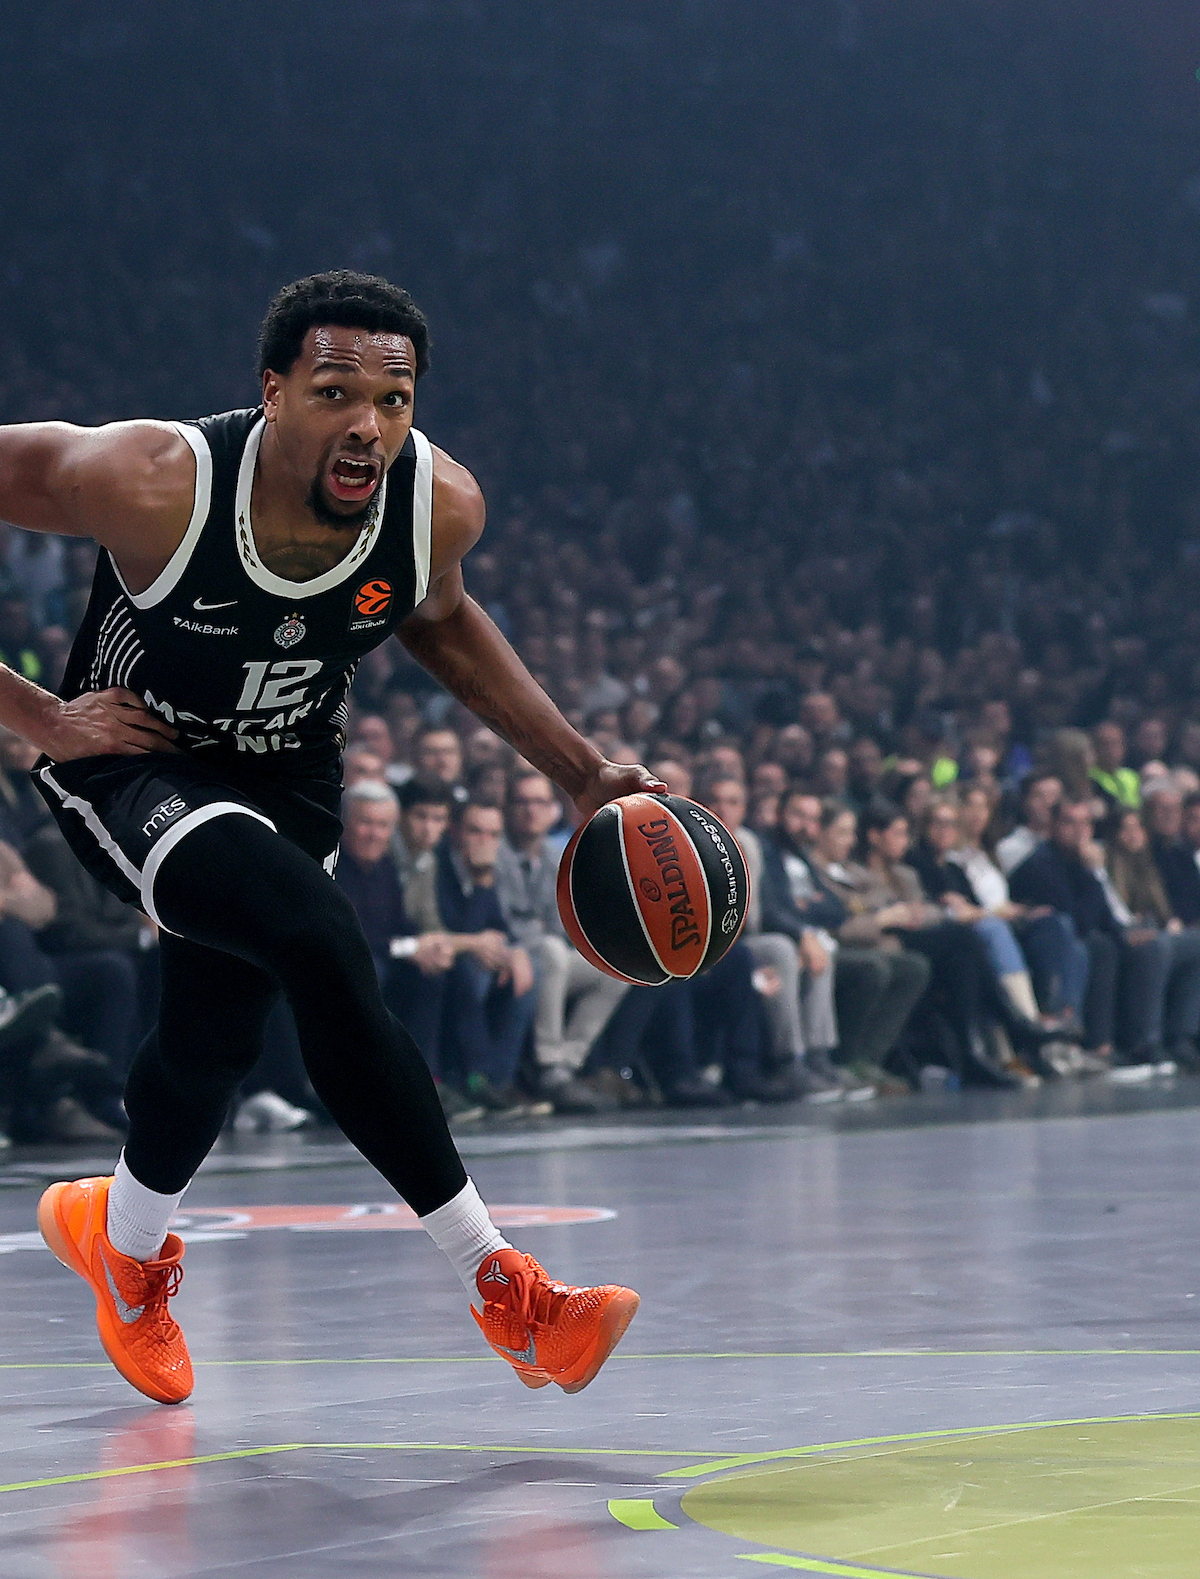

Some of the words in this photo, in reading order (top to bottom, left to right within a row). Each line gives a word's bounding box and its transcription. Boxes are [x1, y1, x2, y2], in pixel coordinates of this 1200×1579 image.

[181, 620, 238, 636] AikBank
[236, 659, 323, 711] 12
[142, 793, 187, 837] mts
[638, 818, 700, 951] SPALDING
